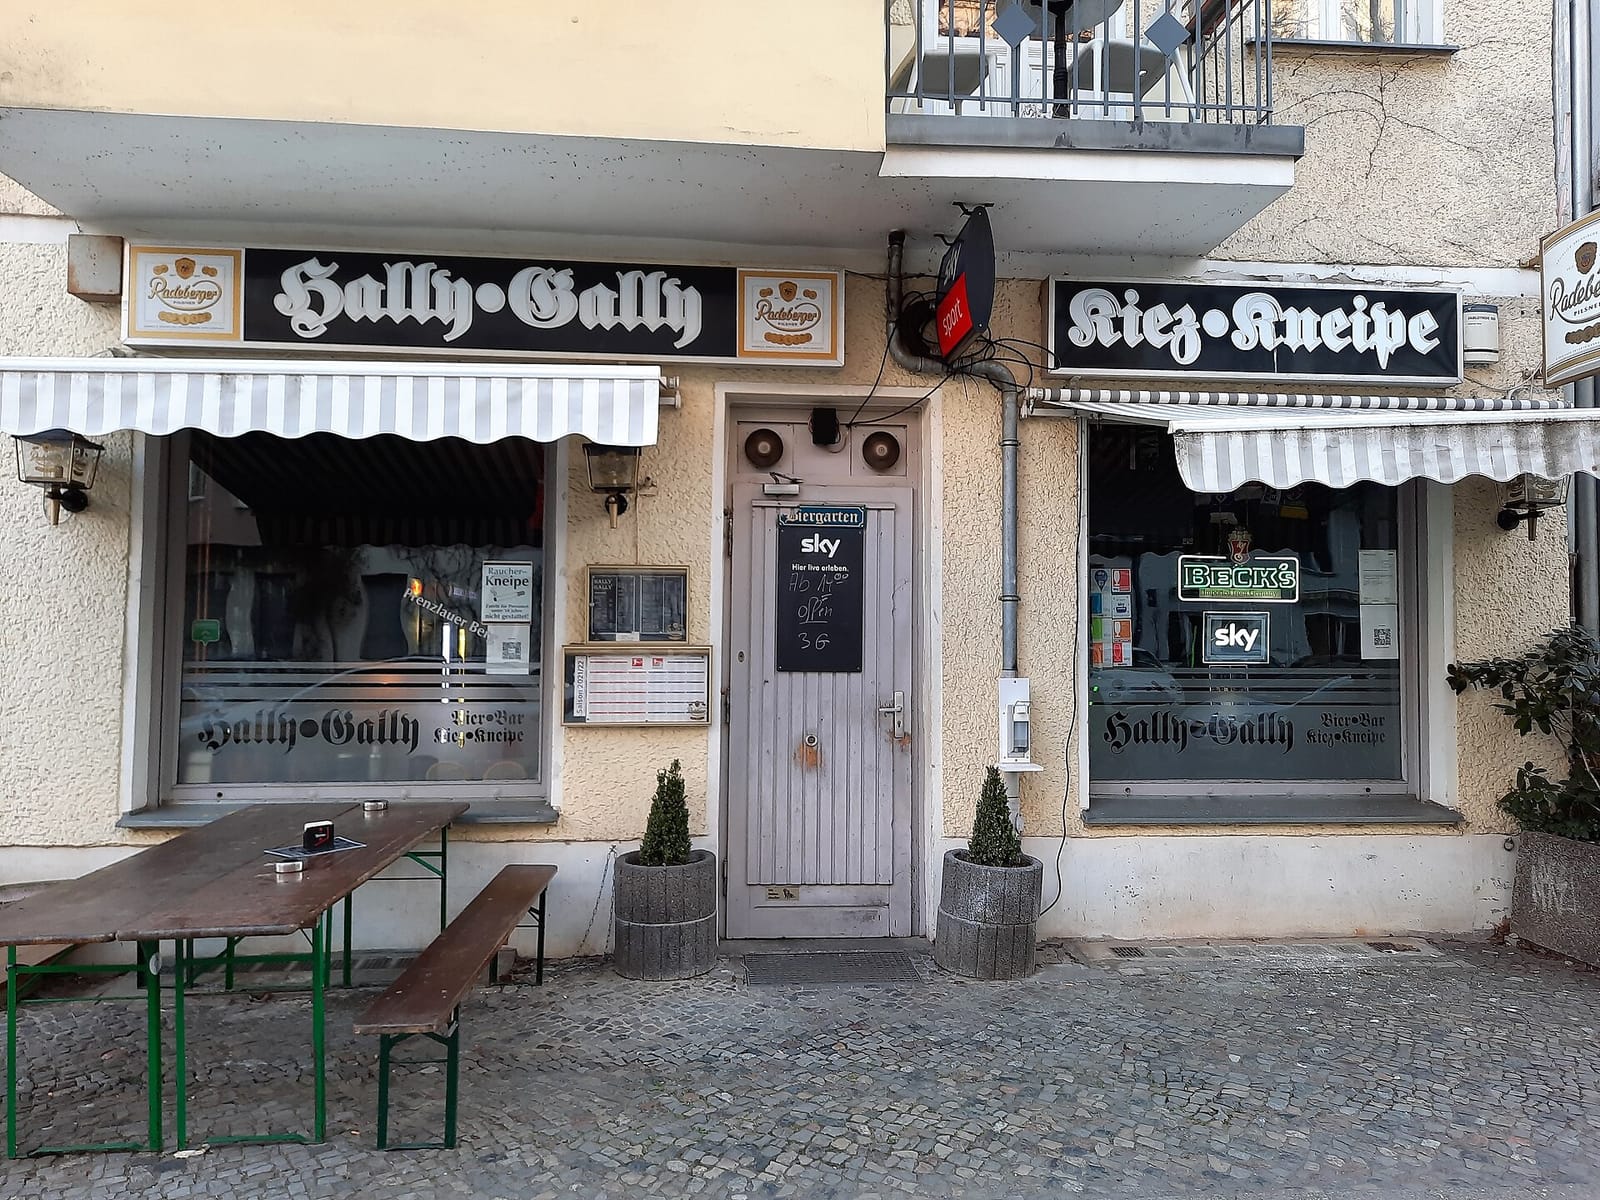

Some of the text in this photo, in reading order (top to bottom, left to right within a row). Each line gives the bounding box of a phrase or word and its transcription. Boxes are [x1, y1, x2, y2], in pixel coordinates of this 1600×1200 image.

[148, 277, 222, 310] Radeberger
[273, 257, 702, 350] Hally Gally
[755, 299, 821, 331] Radeberger
[942, 298, 964, 337] sport
[1068, 288, 1441, 370] Kiez Kneipe
[801, 533, 840, 559] sky
[485, 576, 530, 590] Kneipe
[791, 563, 807, 572] Hier
[808, 564, 820, 572] live
[403, 588, 467, 627] Prenzlauer
[1214, 622, 1259, 652] sky
[576, 660, 584, 714] Saison 2021/22
[198, 708, 419, 755] Hally Gally
[1103, 711, 1188, 755] Hally
[1319, 712, 1351, 728] Bier
[474, 727, 524, 747] Kneipe
